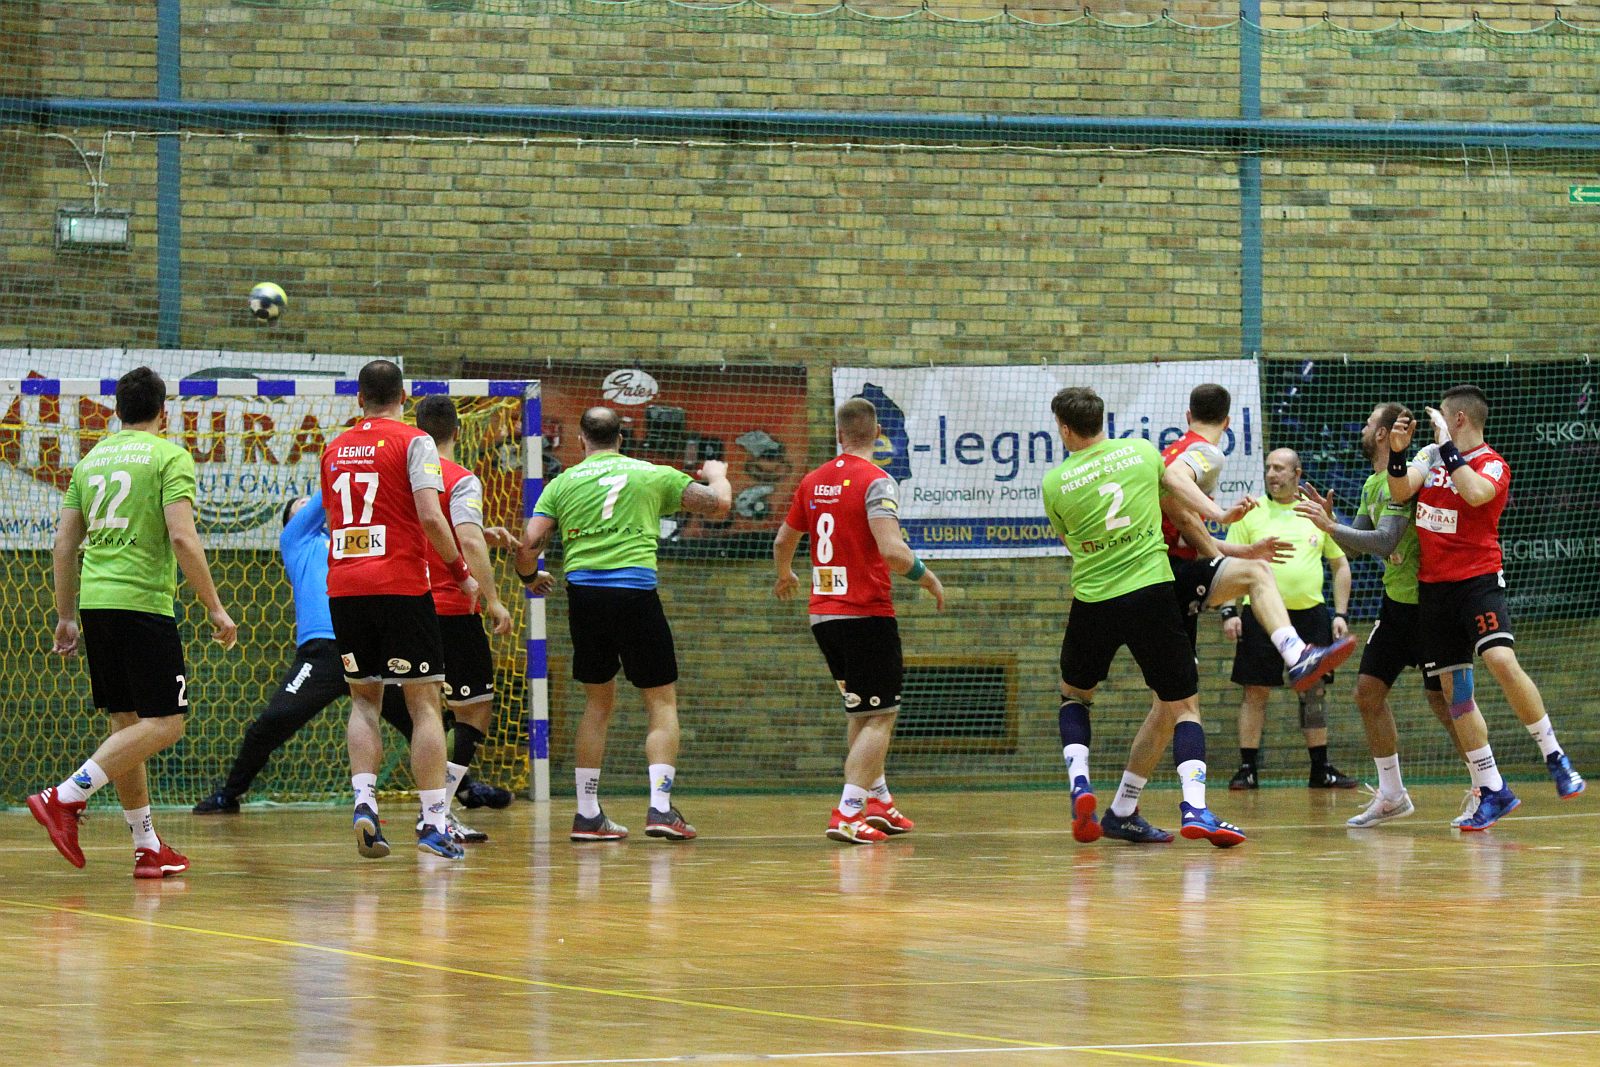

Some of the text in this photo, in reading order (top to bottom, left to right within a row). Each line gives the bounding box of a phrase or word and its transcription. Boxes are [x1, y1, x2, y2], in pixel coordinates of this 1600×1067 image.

[603, 373, 656, 400] Gates
[337, 446, 376, 458] LEGNICA
[1061, 446, 1136, 481] OLIMPIA MEDEX
[1060, 455, 1145, 495] PIEKARY ŚLĄSKIE
[87, 471, 131, 532] 22
[332, 471, 379, 525] 17
[598, 473, 628, 520] 7
[913, 485, 994, 505] Regionalny
[1000, 484, 1040, 501] Portal
[1098, 482, 1131, 531] 2
[816, 512, 835, 564] 8
[923, 526, 972, 542] LUBIN
[1475, 611, 1499, 635] 33
[175, 675, 188, 707] 2
[285, 662, 313, 695] Kempa
